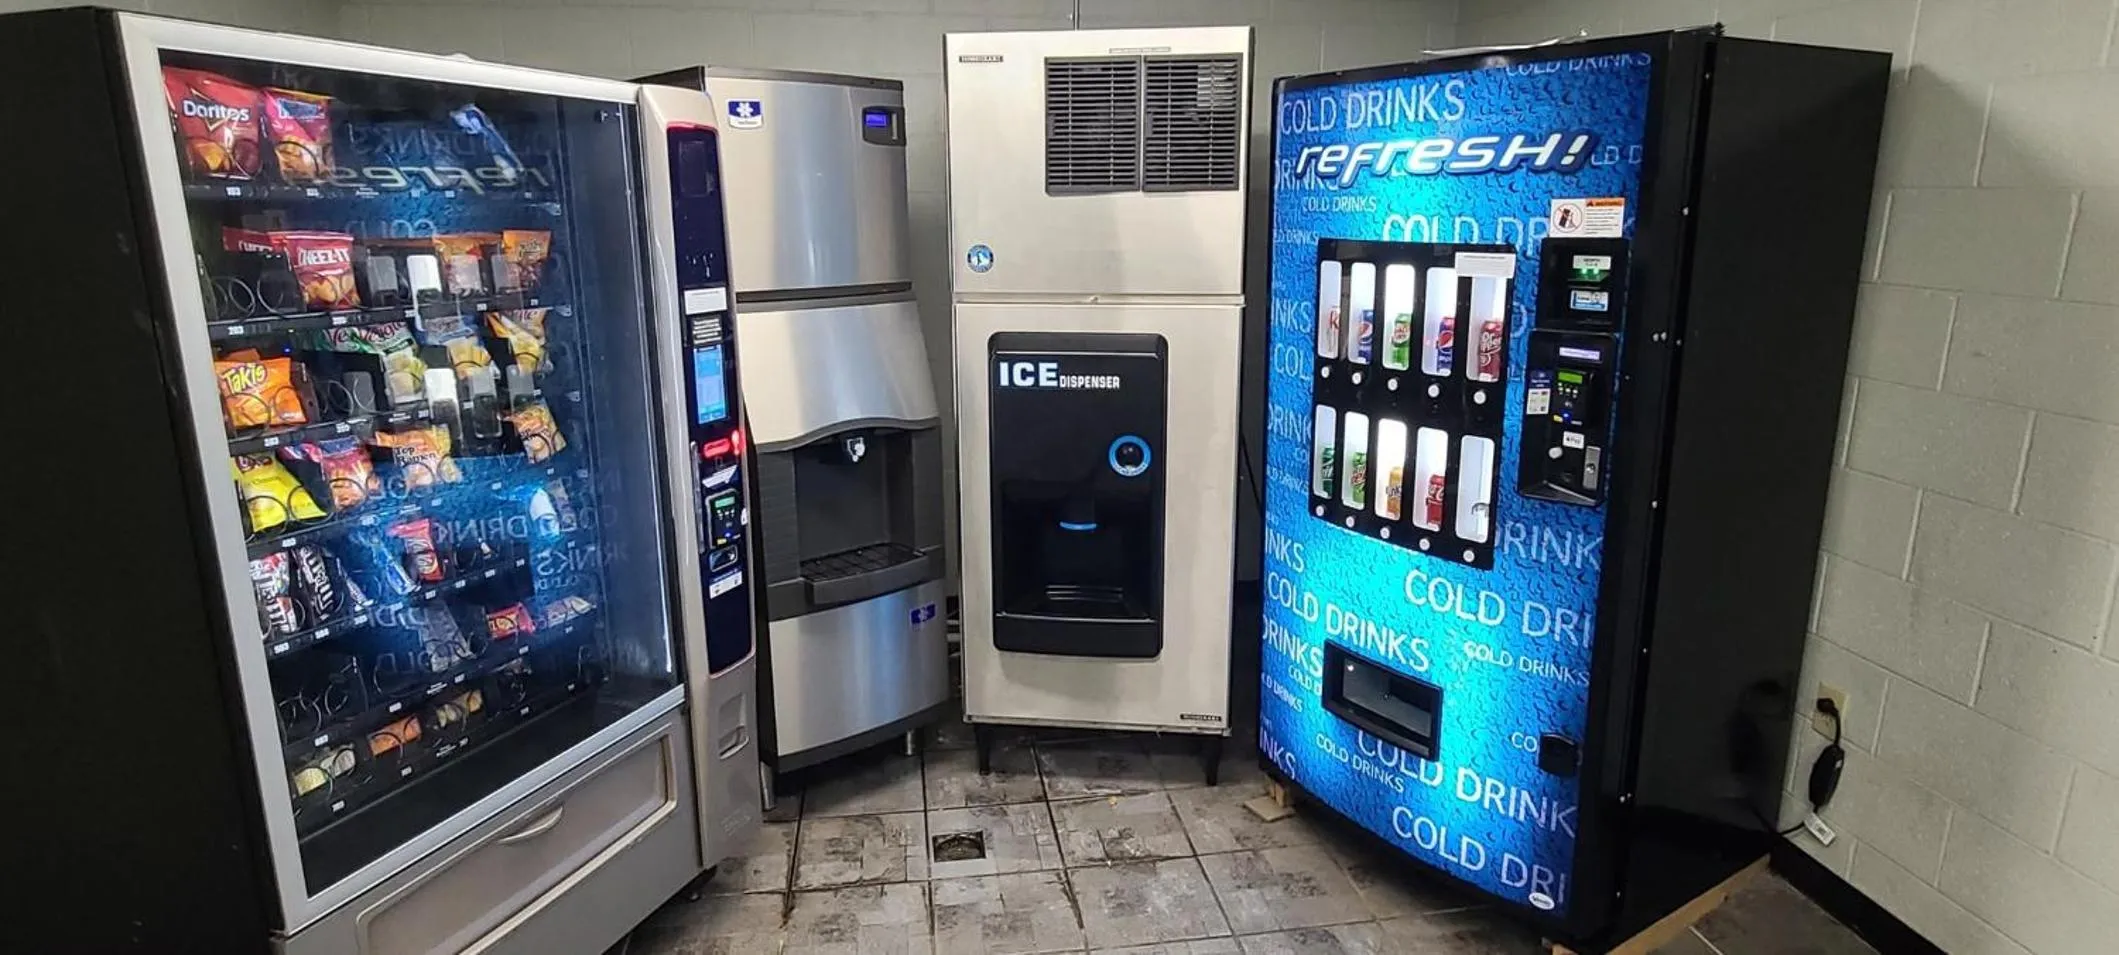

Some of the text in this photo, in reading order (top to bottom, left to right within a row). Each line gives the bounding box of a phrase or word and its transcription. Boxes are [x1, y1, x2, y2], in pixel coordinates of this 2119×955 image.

[183, 100, 250, 122] Doritos
[1280, 79, 1465, 135] COLD DRINKS
[1332, 195, 1376, 212] DRINKS
[1000, 362, 1120, 389] ICE DISPENSER
[1274, 343, 1310, 381] COL
[1503, 521, 1603, 570] RINK
[1268, 571, 1429, 673] COLD DRINKS
[1405, 568, 1505, 626] COLD
[1463, 640, 1591, 687] COLD DRINKS
[1316, 733, 1404, 793] COLD DRINKS
[1358, 731, 1577, 839] COLD DRINK
[1392, 806, 1485, 871] COLD
